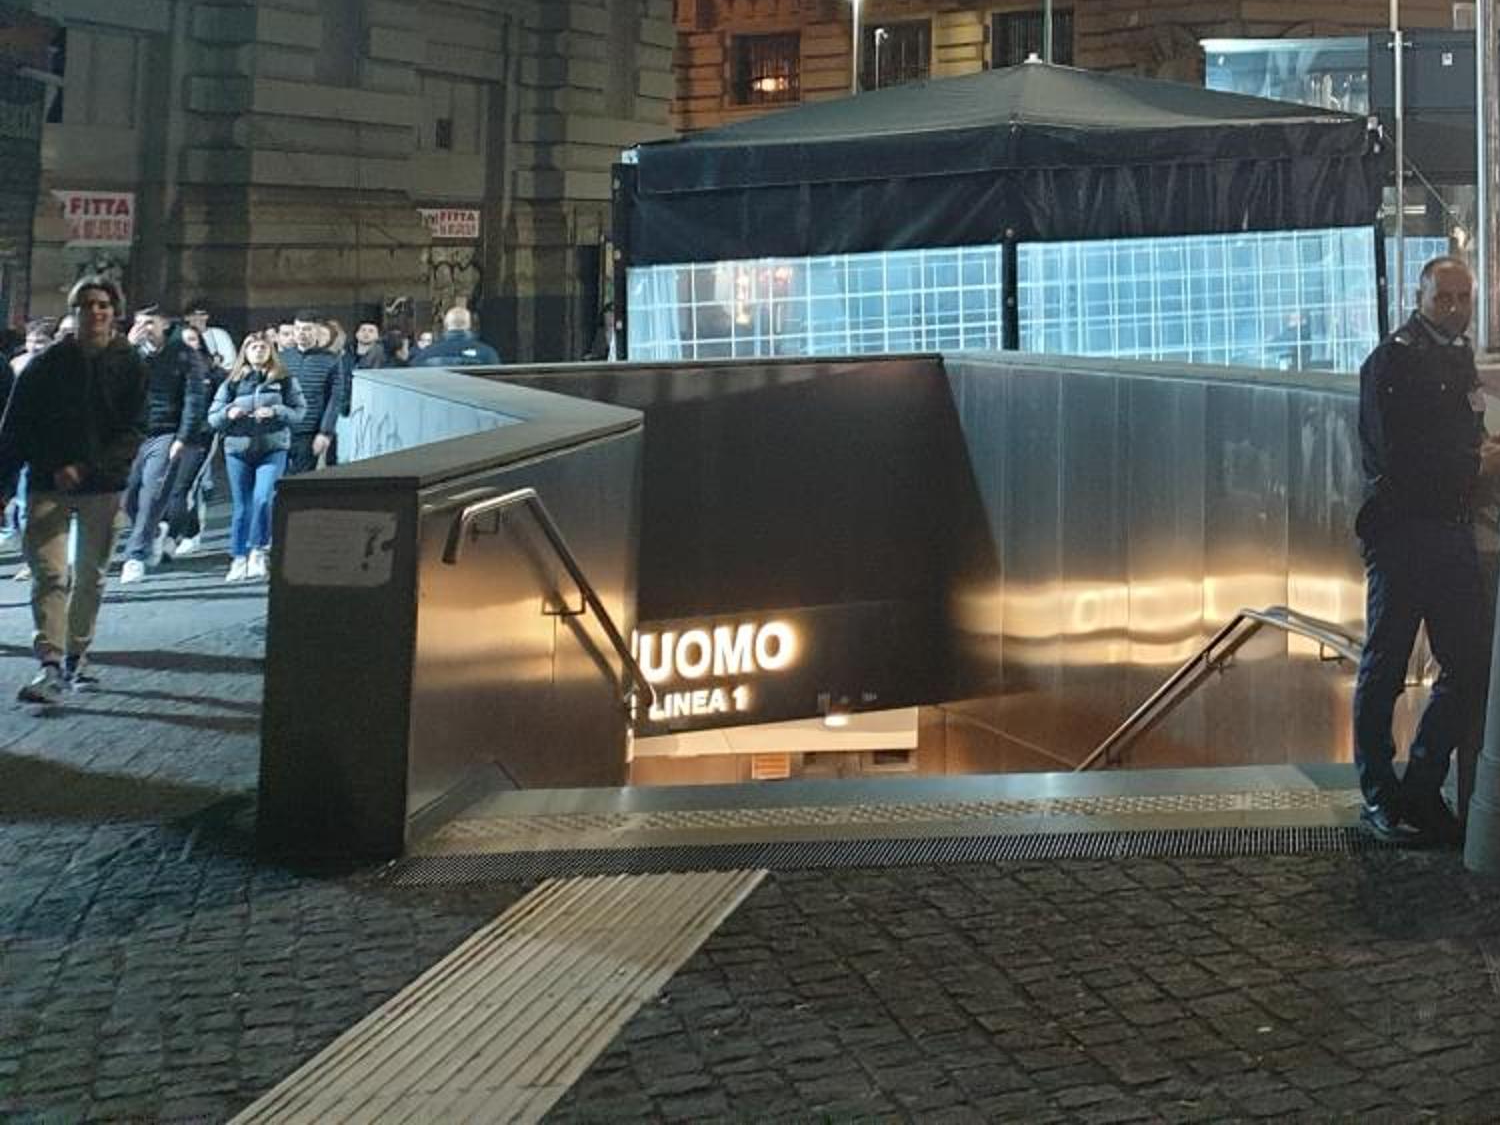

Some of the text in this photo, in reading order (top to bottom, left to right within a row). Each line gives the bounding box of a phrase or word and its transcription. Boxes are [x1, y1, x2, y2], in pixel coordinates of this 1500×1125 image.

[69, 197, 129, 215] FITTA
[649, 684, 751, 721] LINEA 1
